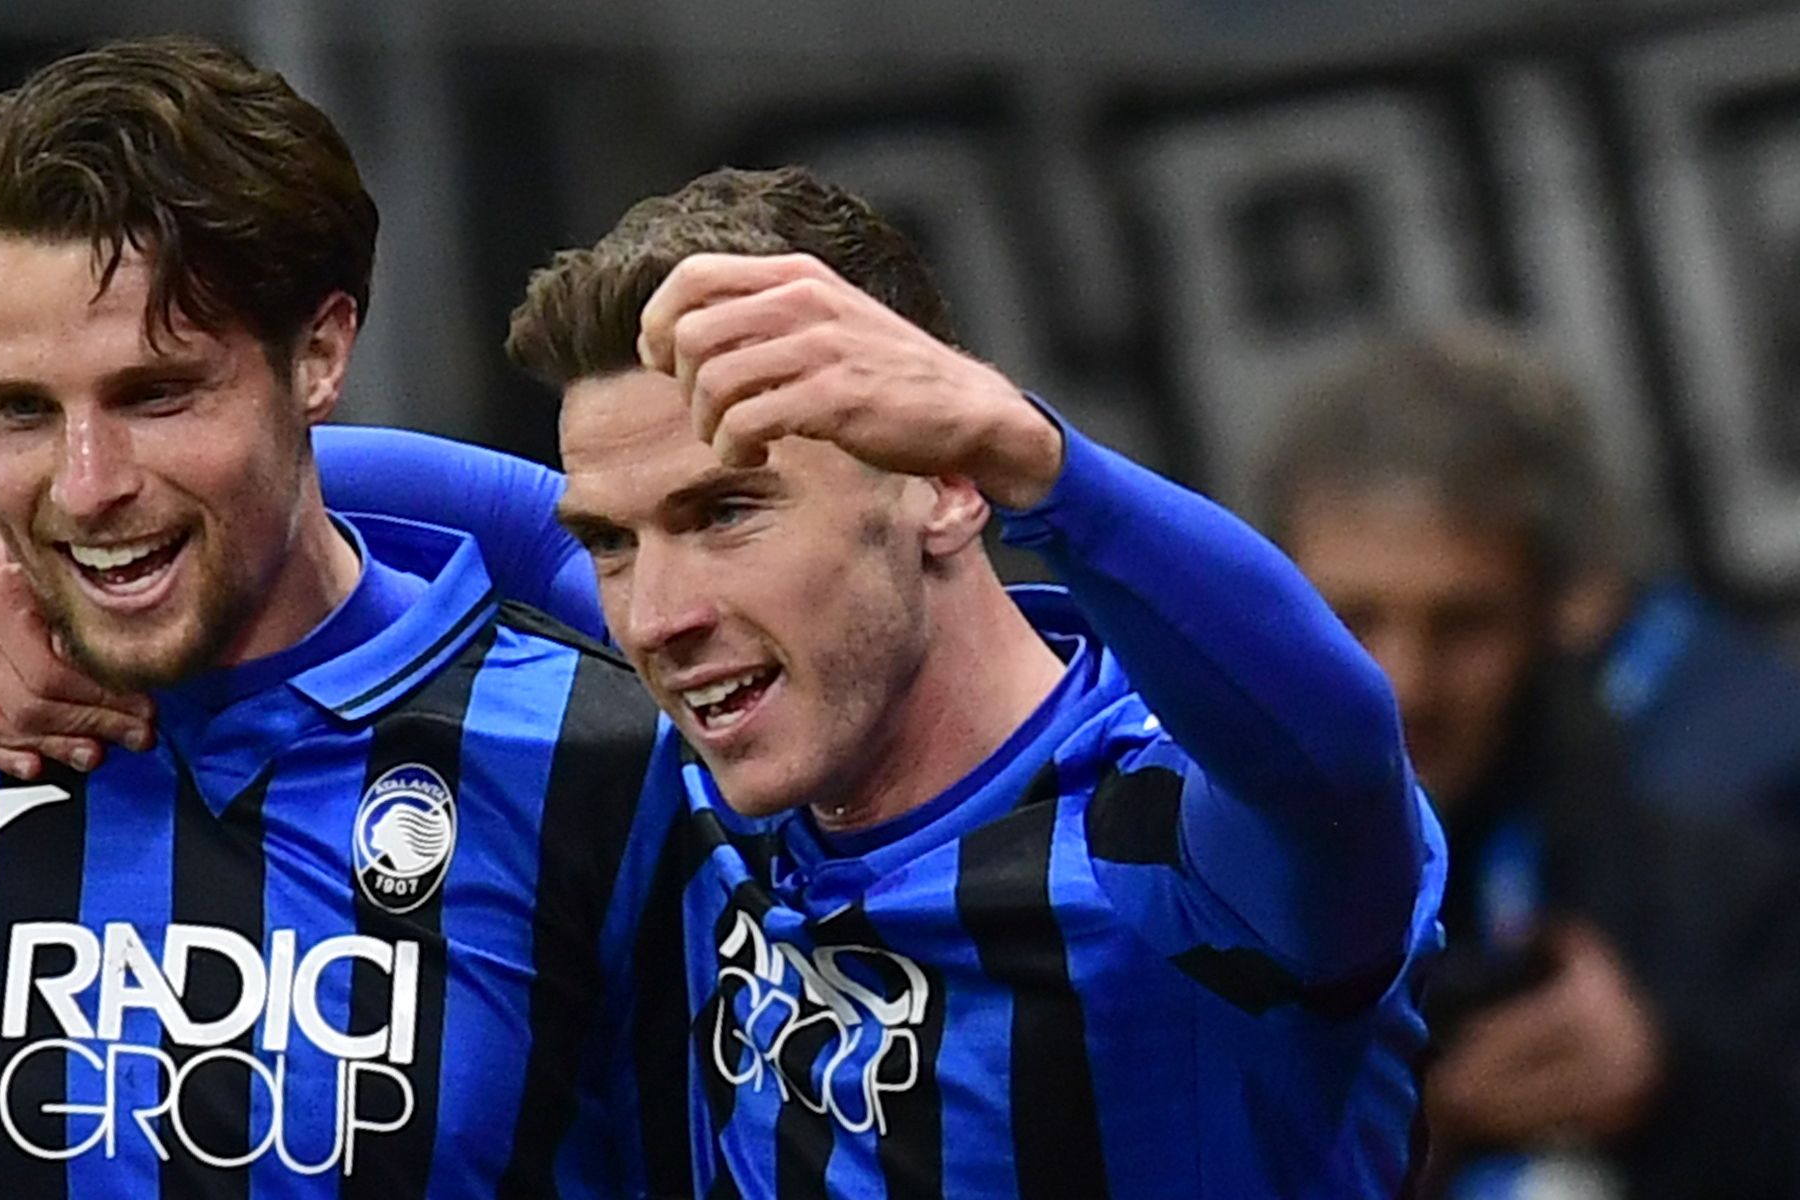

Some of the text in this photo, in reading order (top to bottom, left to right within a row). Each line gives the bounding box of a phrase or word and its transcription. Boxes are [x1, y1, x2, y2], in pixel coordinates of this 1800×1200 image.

[375, 874, 419, 896] 1907
[2, 922, 419, 1064] RADICI
[0, 1038, 414, 1177] GROUP
